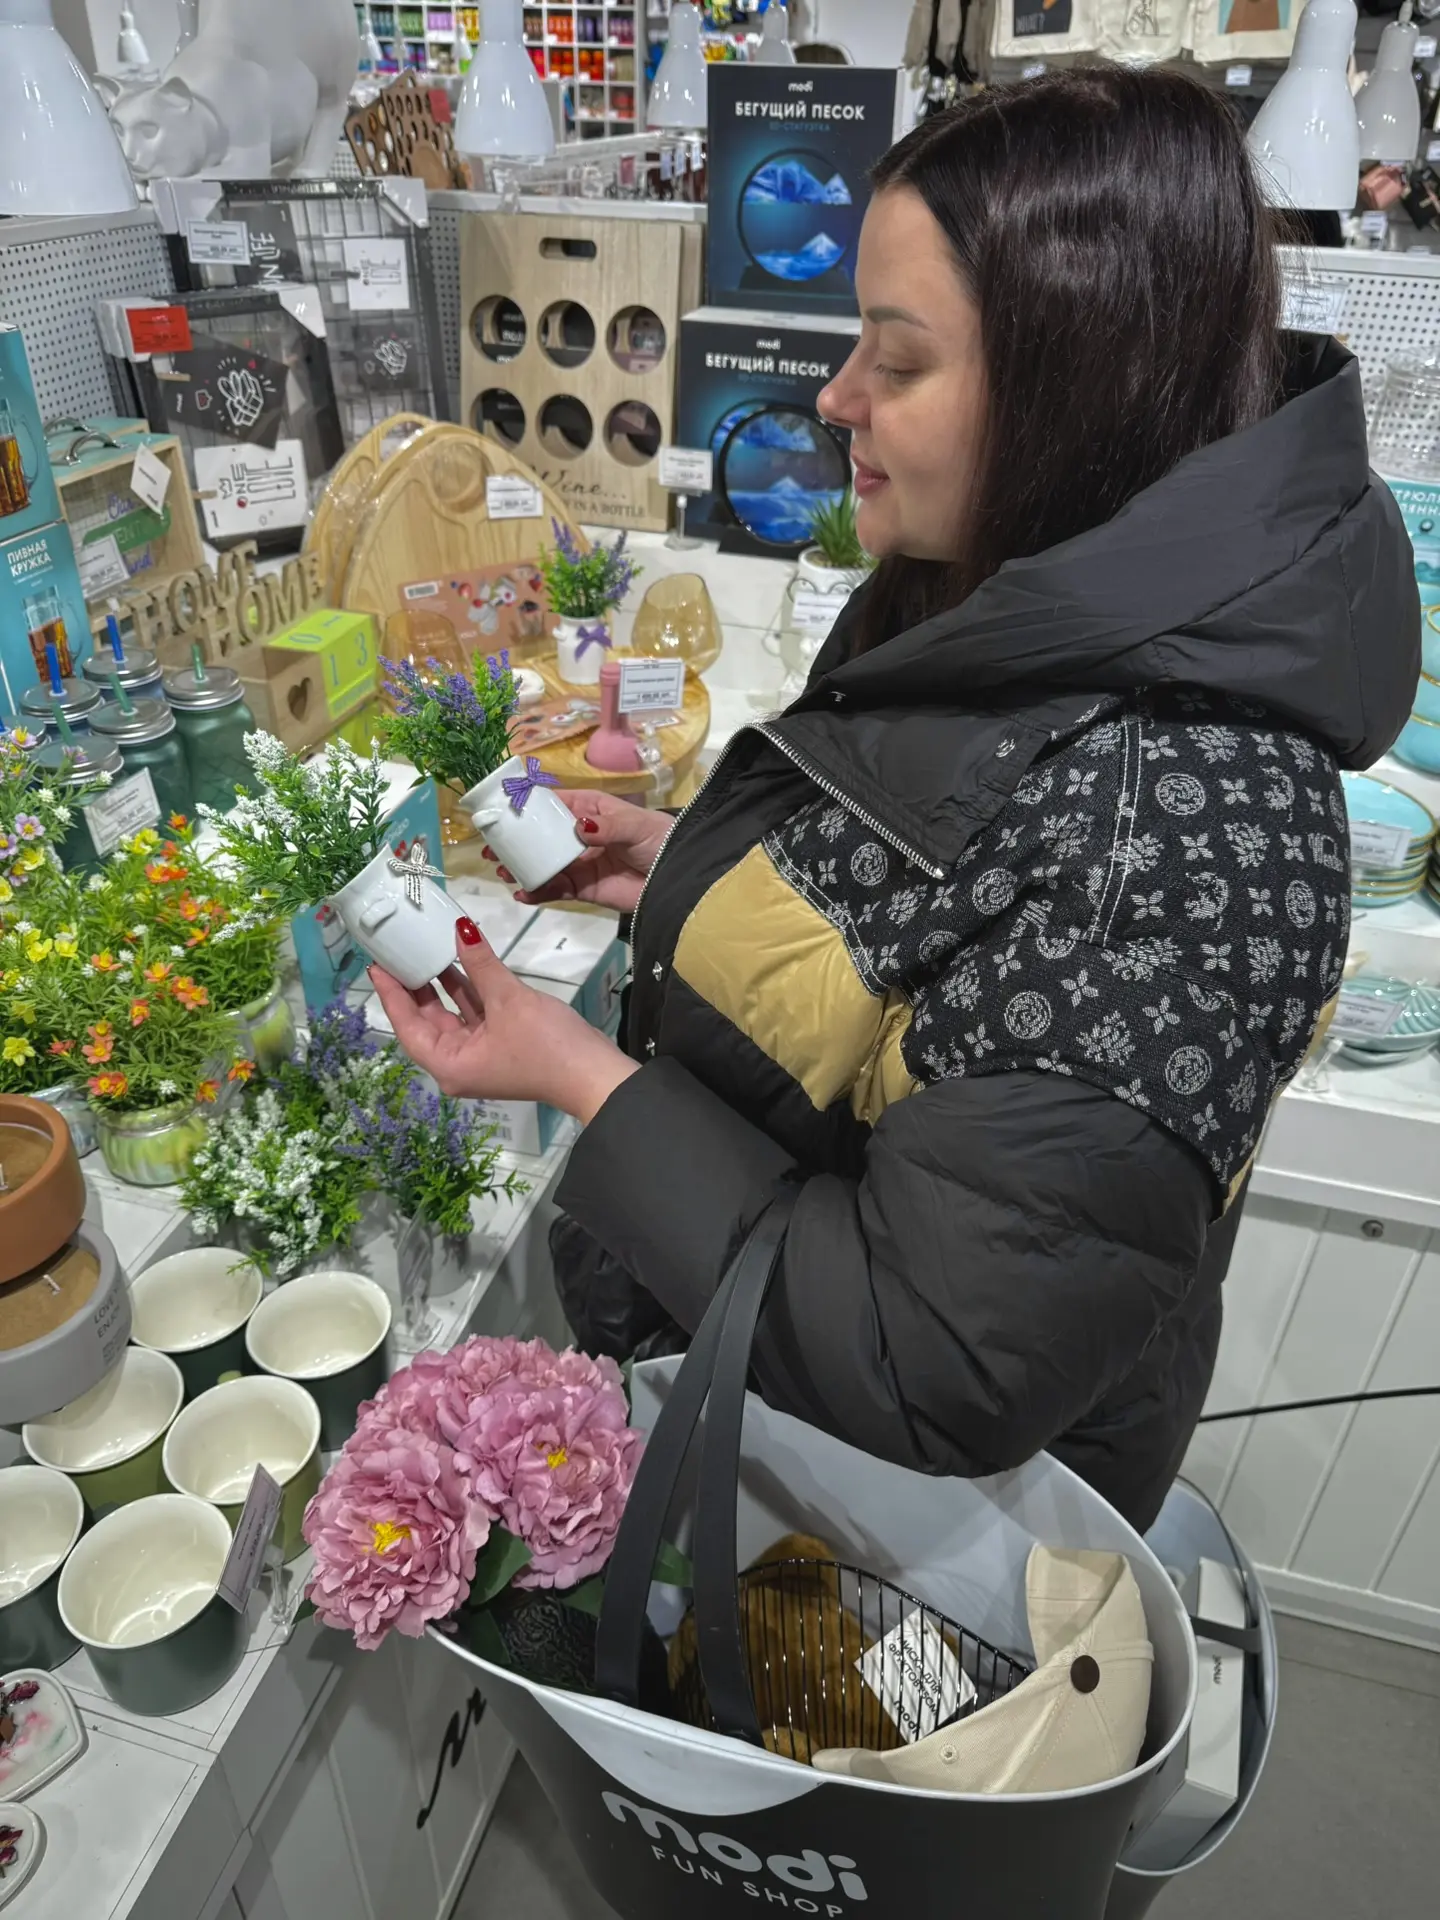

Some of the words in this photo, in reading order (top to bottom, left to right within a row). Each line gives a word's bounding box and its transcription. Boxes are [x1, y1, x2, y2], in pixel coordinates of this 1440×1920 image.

[788, 81, 813, 93] modi
[735, 101, 806, 120] БЕГУЩИЙ
[812, 104, 865, 120] ПЕСОК
[756, 338, 781, 351] modi
[705, 352, 775, 373] БЕГУЩИЙ
[778, 359, 831, 378] ПЕСОК
[601, 503, 644, 518] BOTTLE
[7, 539, 48, 565] ПИВНАЯ
[10, 551, 52, 577] КРУЖКА
[125, 540, 259, 648] HOME
[199, 552, 327, 664] HOME
[600, 1790, 869, 1902] modi
[651, 1844, 723, 1886] FUN
[742, 1880, 844, 1919] SHOP
